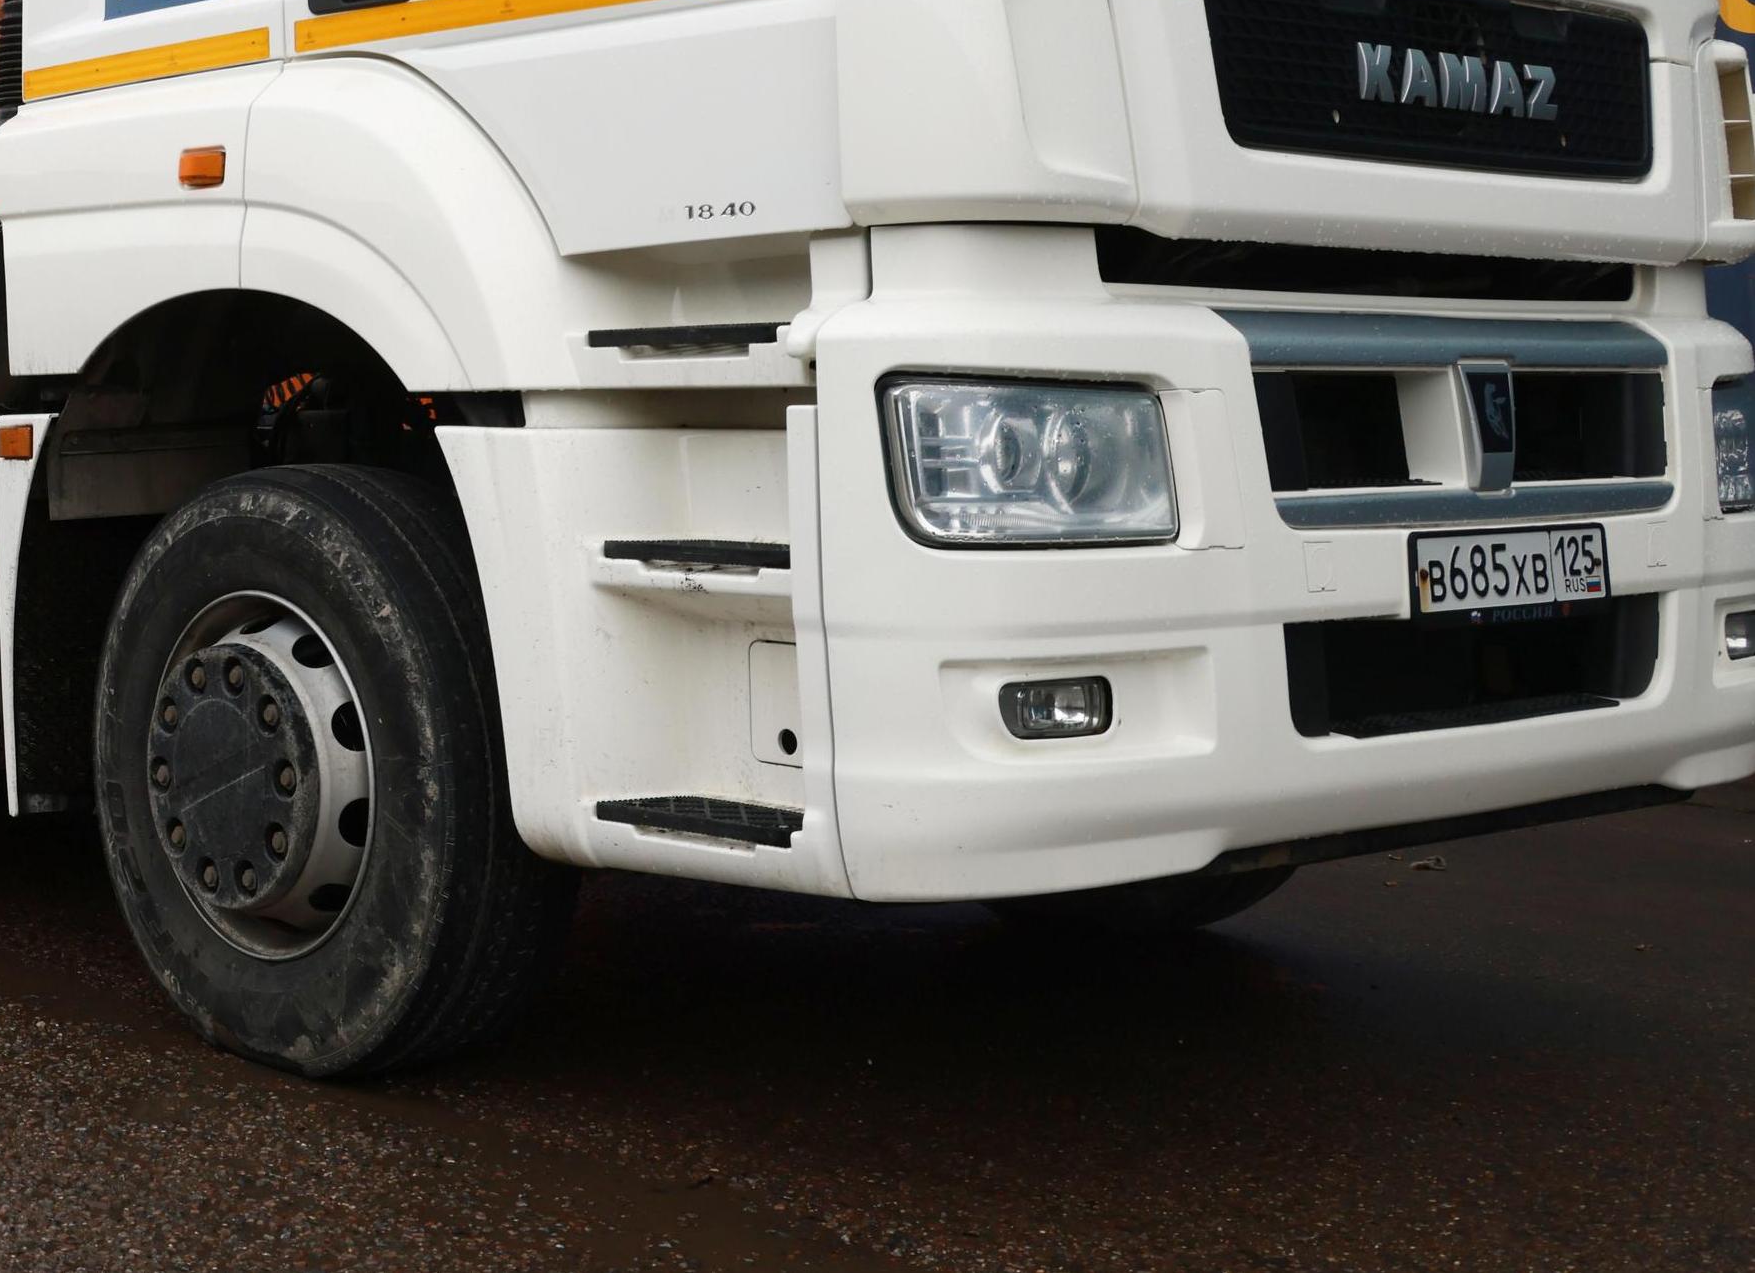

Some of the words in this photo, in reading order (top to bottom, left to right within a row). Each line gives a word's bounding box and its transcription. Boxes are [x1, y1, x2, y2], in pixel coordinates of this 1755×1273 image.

[1357, 41, 1558, 121] KAMAZ
[1554, 535, 1595, 577] 125
[1565, 578, 1586, 593] RUS
